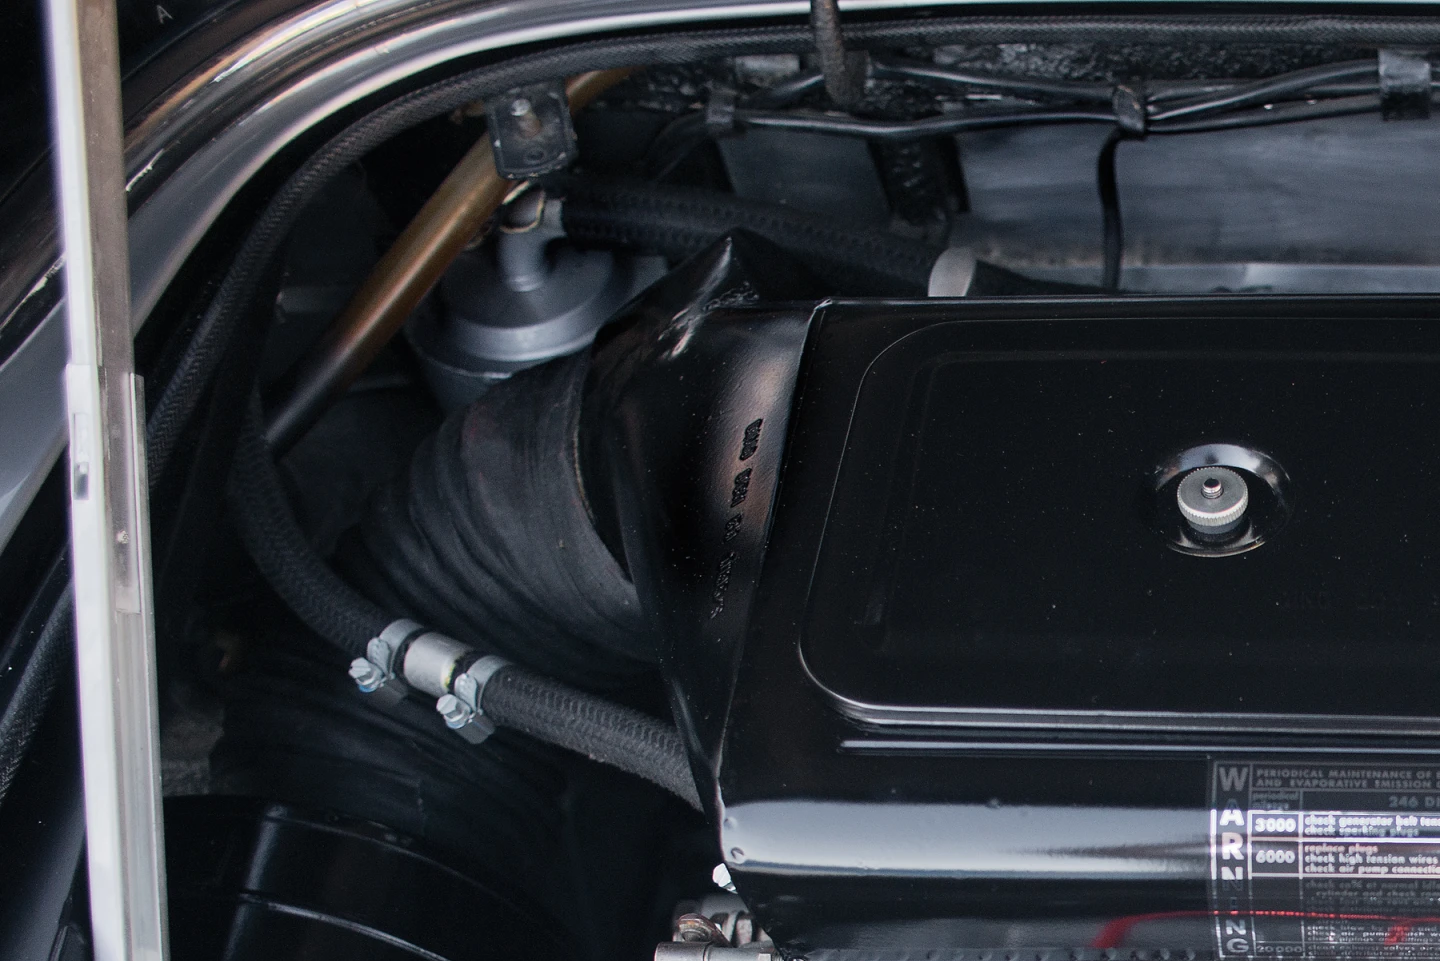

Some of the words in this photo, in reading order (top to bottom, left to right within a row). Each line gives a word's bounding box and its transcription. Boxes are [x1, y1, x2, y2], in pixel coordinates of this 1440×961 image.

[1255, 768, 1324, 779] PERIODICAL
[1328, 769, 1413, 780] MAINTENANCE
[1416, 770, 1432, 780] OF
[1255, 779, 1282, 788] AND
[1289, 779, 1368, 789] EVAPORATIVE
[1374, 780, 1432, 789] EMISSION
[1388, 796, 1419, 808] 246
[1254, 818, 1297, 832] 3000
[1304, 814, 1336, 826] check
[1338, 816, 1394, 828] generator
[1395, 815, 1418, 826] belt
[1304, 825, 1335, 836] check
[1304, 843, 1346, 855] replace
[1348, 843, 1378, 855] plugs
[1255, 849, 1296, 864] 6000
[1304, 853, 1336, 864] check
[1339, 853, 1363, 867] high
[1366, 853, 1406, 864] tension
[1408, 854, 1439, 865] wires
[1304, 863, 1336, 874] check
[1339, 864, 1355, 874] air
[1357, 865, 1389, 876] pump
[1305, 880, 1335, 890] check
[1362, 889, 1383, 898] and
[1256, 945, 1302, 953] 20000
